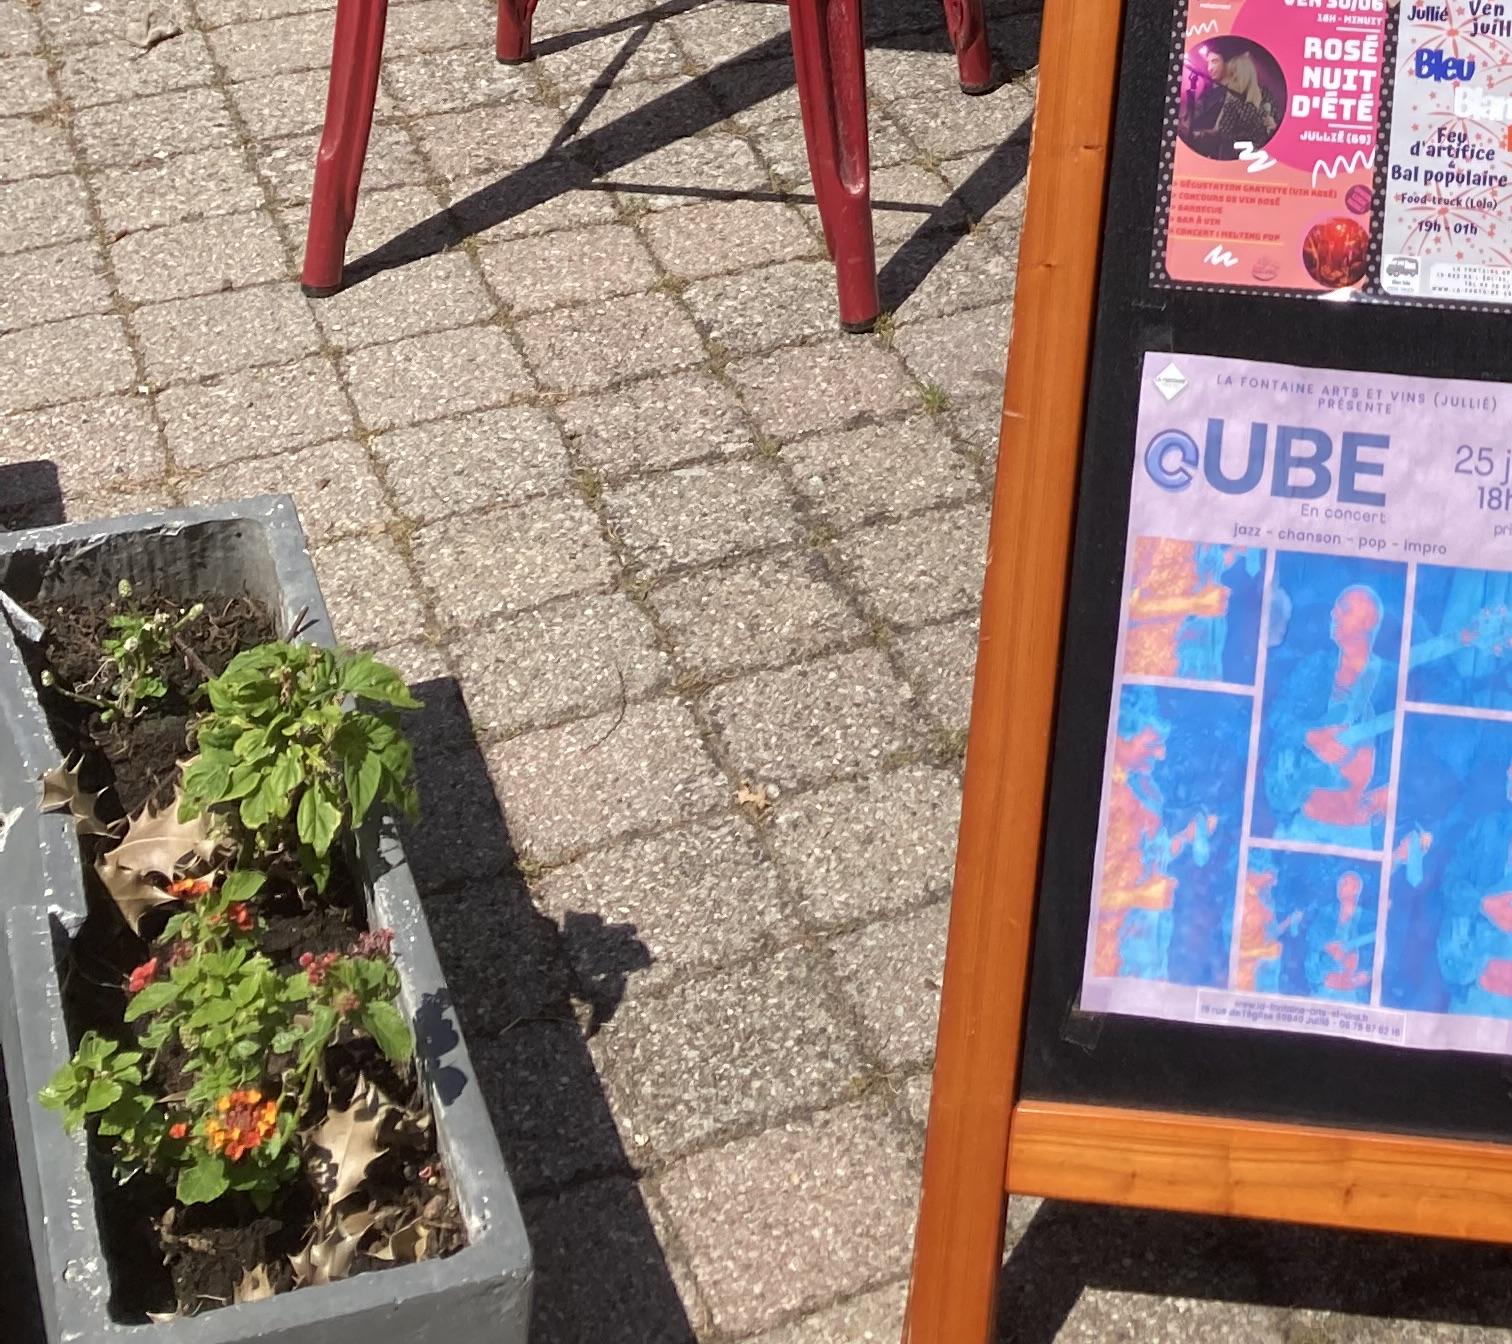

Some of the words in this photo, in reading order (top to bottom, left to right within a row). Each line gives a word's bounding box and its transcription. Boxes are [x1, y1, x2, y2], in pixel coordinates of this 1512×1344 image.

[1317, 13, 1336, 23] 18H
[1344, 15, 1382, 25] MINUIT
[1407, 5, 1449, 22] Jullié
[1468, 0, 1504, 17] Ven
[1304, 35, 1379, 63] ROSÉ
[1415, 48, 1475, 82] Bleu
[1302, 66, 1377, 91] NUIT
[1291, 90, 1374, 121] D'ÉTÉ
[1300, 129, 1344, 143] JULLIÉ
[1347, 133, 1371, 146] (69)
[1437, 127, 1467, 144] Feu
[1410, 141, 1495, 161] d'artifice
[1391, 165, 1419, 182] Bal
[1424, 167, 1508, 188] populaire
[1418, 220, 1441, 233] 19h
[1454, 222, 1478, 235] 01h
[1217, 375, 1233, 386] LA
[1240, 376, 1314, 395] FONTAINE
[1321, 385, 1359, 399] ARTS
[1366, 388, 1382, 400] ET
[1391, 391, 1425, 404] VINS
[1433, 392, 1497, 412] (JULLIÉ)
[1318, 398, 1392, 414] PRÉSENTE
[1145, 418, 1390, 507] CUBE
[1454, 444, 1494, 477] 25
[1301, 505, 1319, 518] En
[1325, 506, 1387, 524] concert
[1233, 523, 1262, 538] jazz
[1278, 528, 1341, 545] chanson
[1358, 535, 1386, 552] pop
